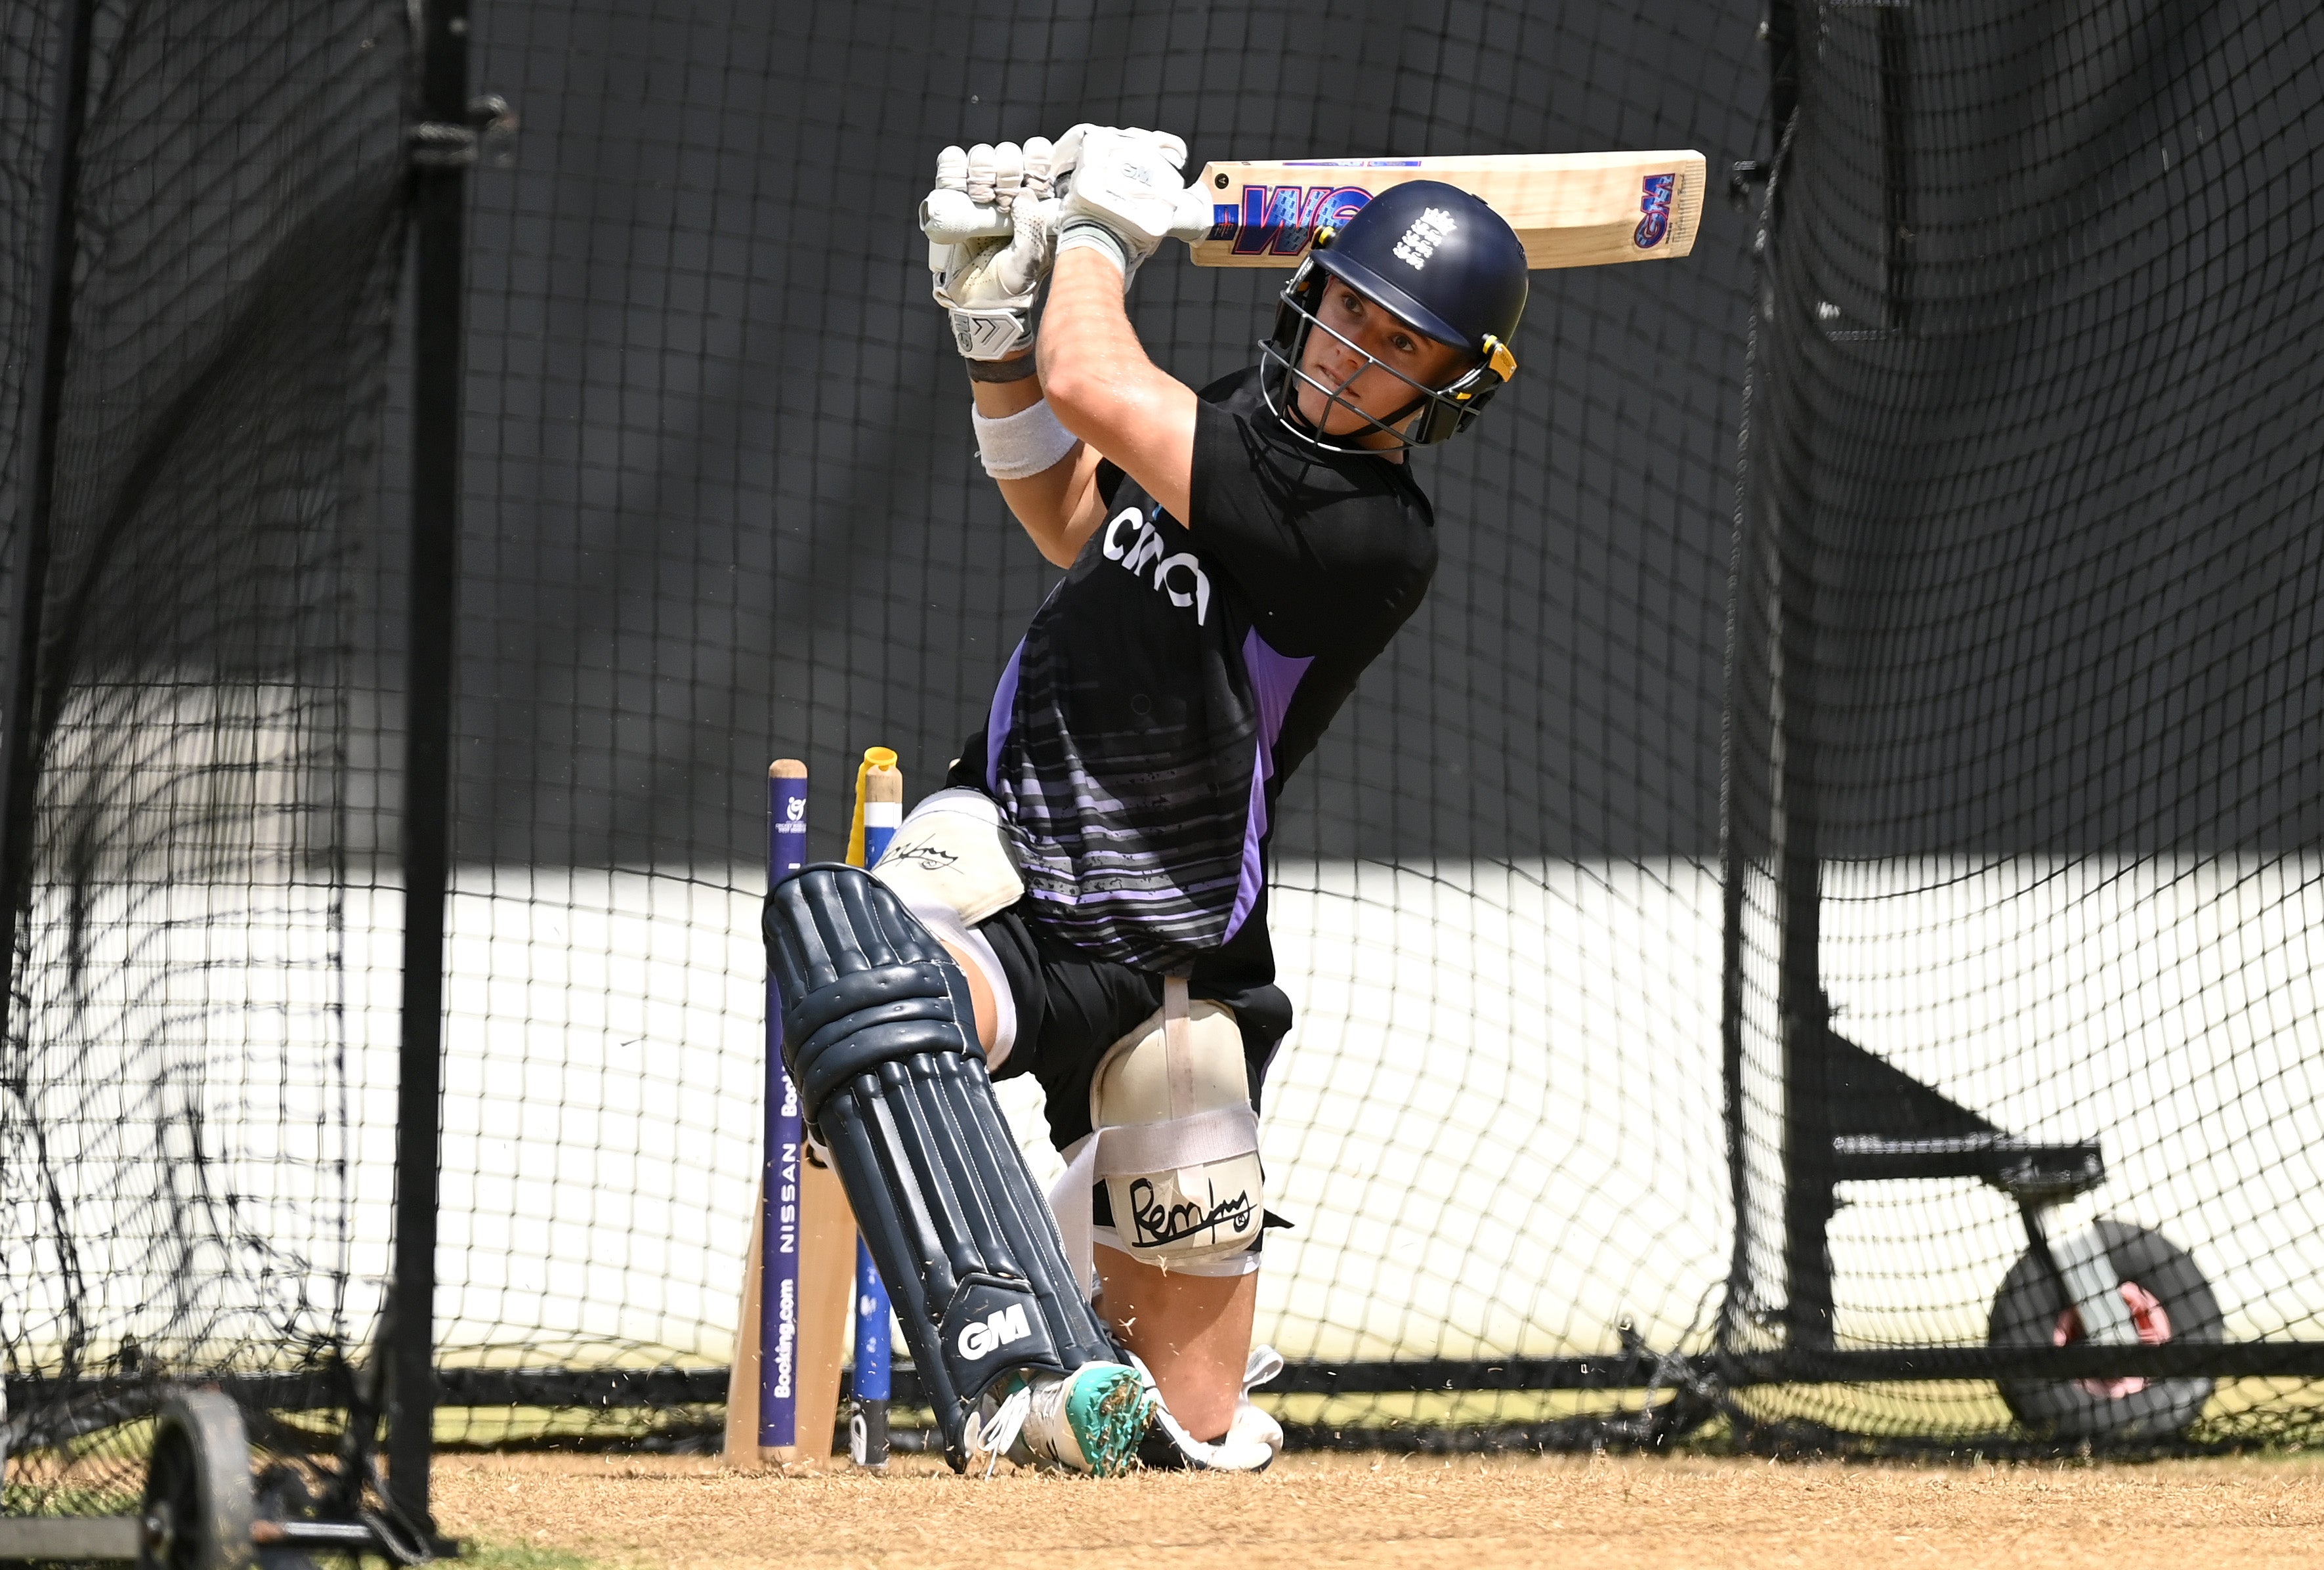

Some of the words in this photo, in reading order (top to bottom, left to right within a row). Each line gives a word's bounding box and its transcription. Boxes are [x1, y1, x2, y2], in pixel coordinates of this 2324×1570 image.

[1634, 173, 1676, 249] GM
[954, 314, 973, 352] GM
[780, 1143, 797, 1253] NISSAN
[774, 1279, 795, 1398] Booking.com
[958, 1303, 1032, 1361] GM
